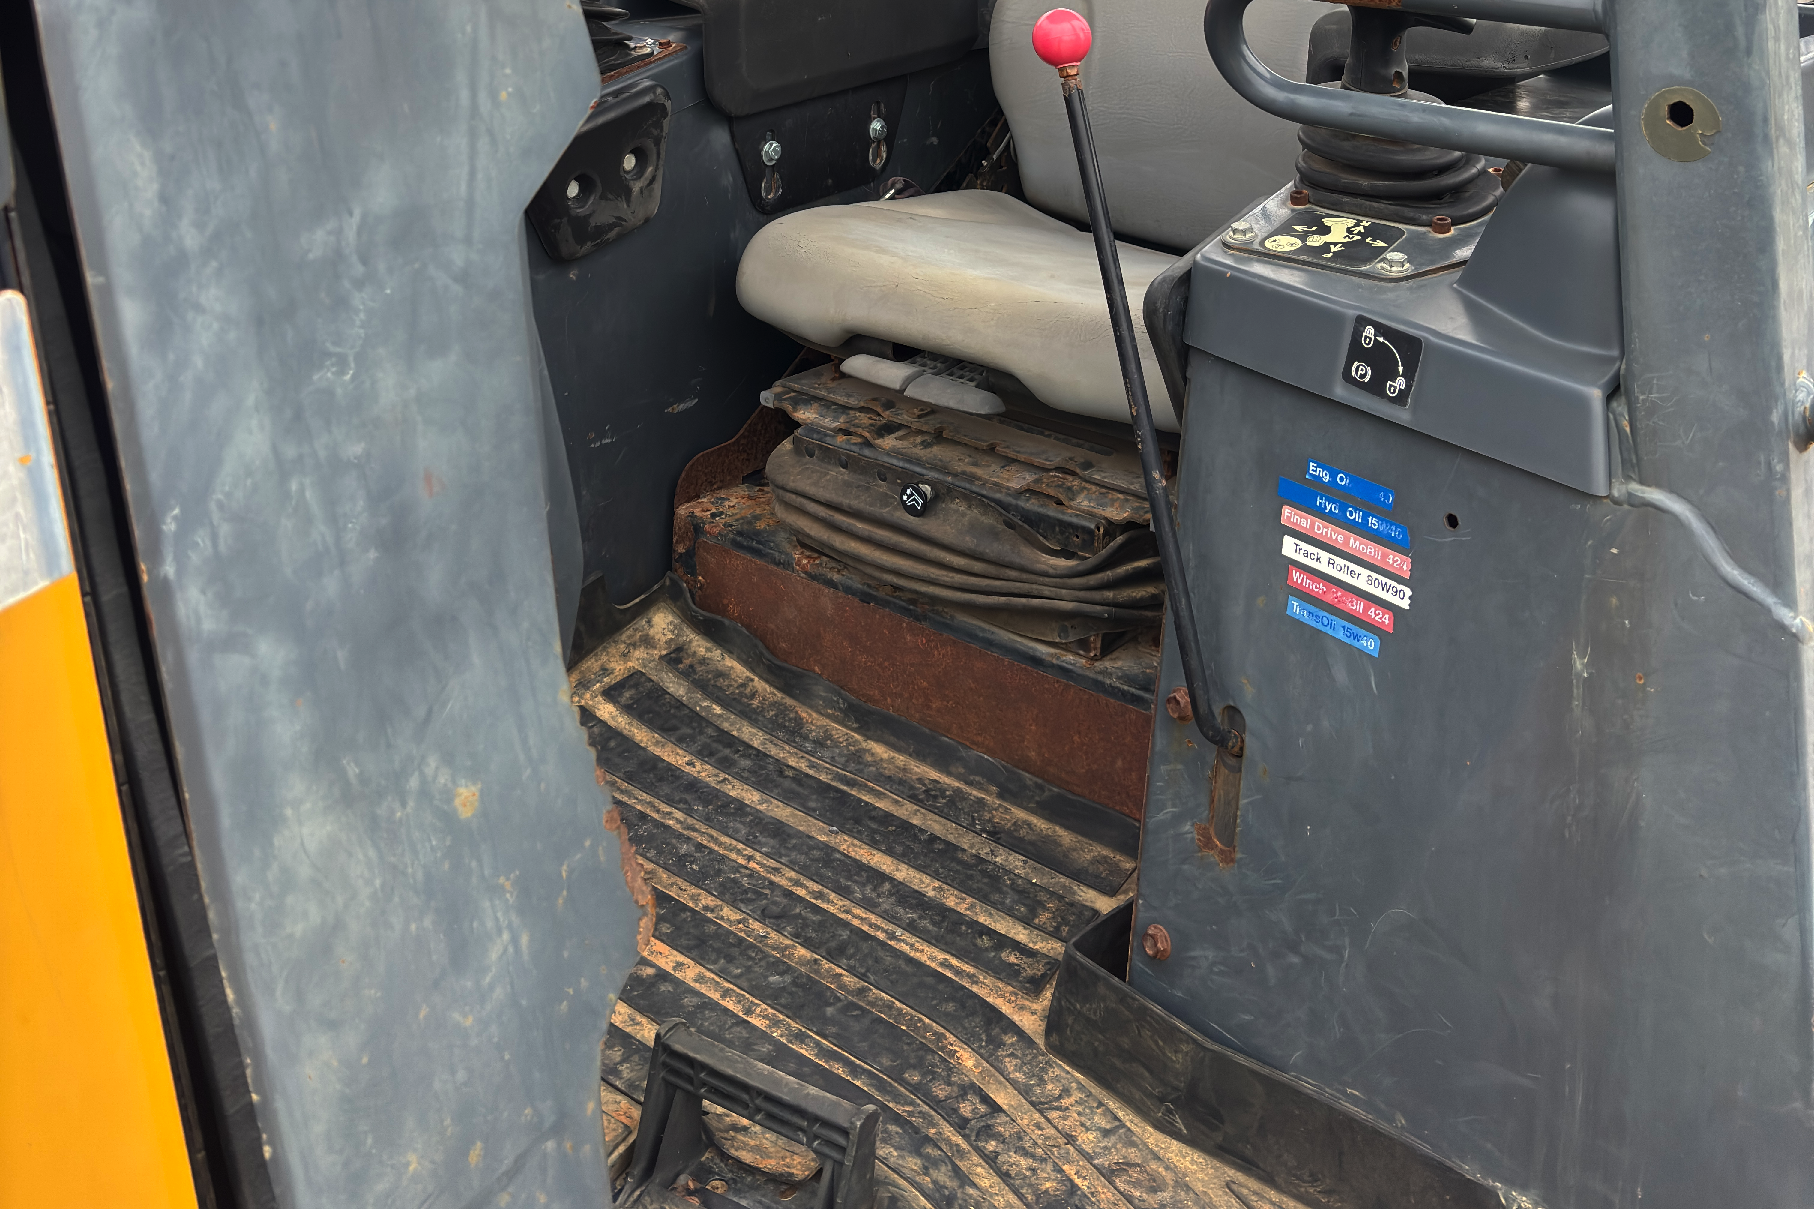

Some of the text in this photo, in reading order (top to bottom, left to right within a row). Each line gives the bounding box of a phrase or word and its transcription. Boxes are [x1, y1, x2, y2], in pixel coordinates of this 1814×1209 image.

[1336, 473, 1351, 487] Oi
[1284, 508, 1312, 529] Final
[1314, 521, 1345, 543] Drive
[1386, 553, 1408, 571] 424
[1346, 507, 1363, 523] Oil
[1367, 515, 1403, 540] 15W40
[1292, 569, 1327, 595] Winch
[1367, 607, 1390, 626] 424
[1293, 542, 1406, 601] Track Roller 80W90
